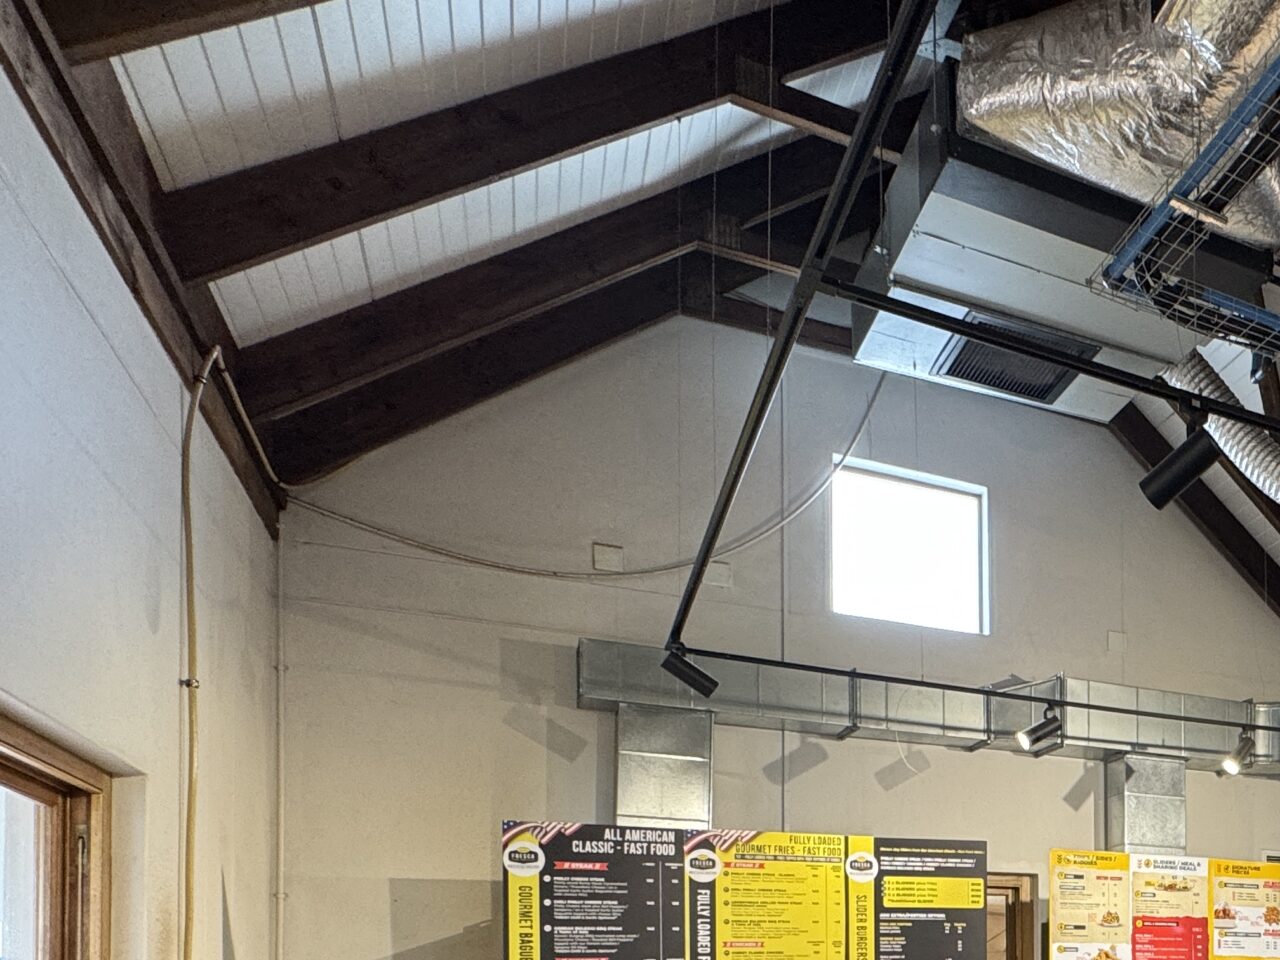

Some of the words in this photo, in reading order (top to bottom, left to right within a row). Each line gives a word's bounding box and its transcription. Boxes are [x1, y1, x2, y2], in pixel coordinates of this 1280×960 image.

[604, 828, 622, 840] ALL
[625, 829, 675, 842] AMERICAN
[789, 835, 811, 845] FULLY
[813, 836, 842, 846] LOADED
[572, 840, 614, 853] CLASSIC
[624, 843, 648, 855] FAST
[650, 844, 675, 856] FOOD
[735, 843, 771, 854] GOURMET
[774, 845, 795, 855] FRIES
[802, 847, 821, 855] FAST
[823, 847, 842, 856] FOOD
[518, 885, 533, 931] GOURMET
[697, 889, 711, 917] FULLY
[856, 894, 868, 924] SLIDER
[697, 918, 711, 954] LOADED
